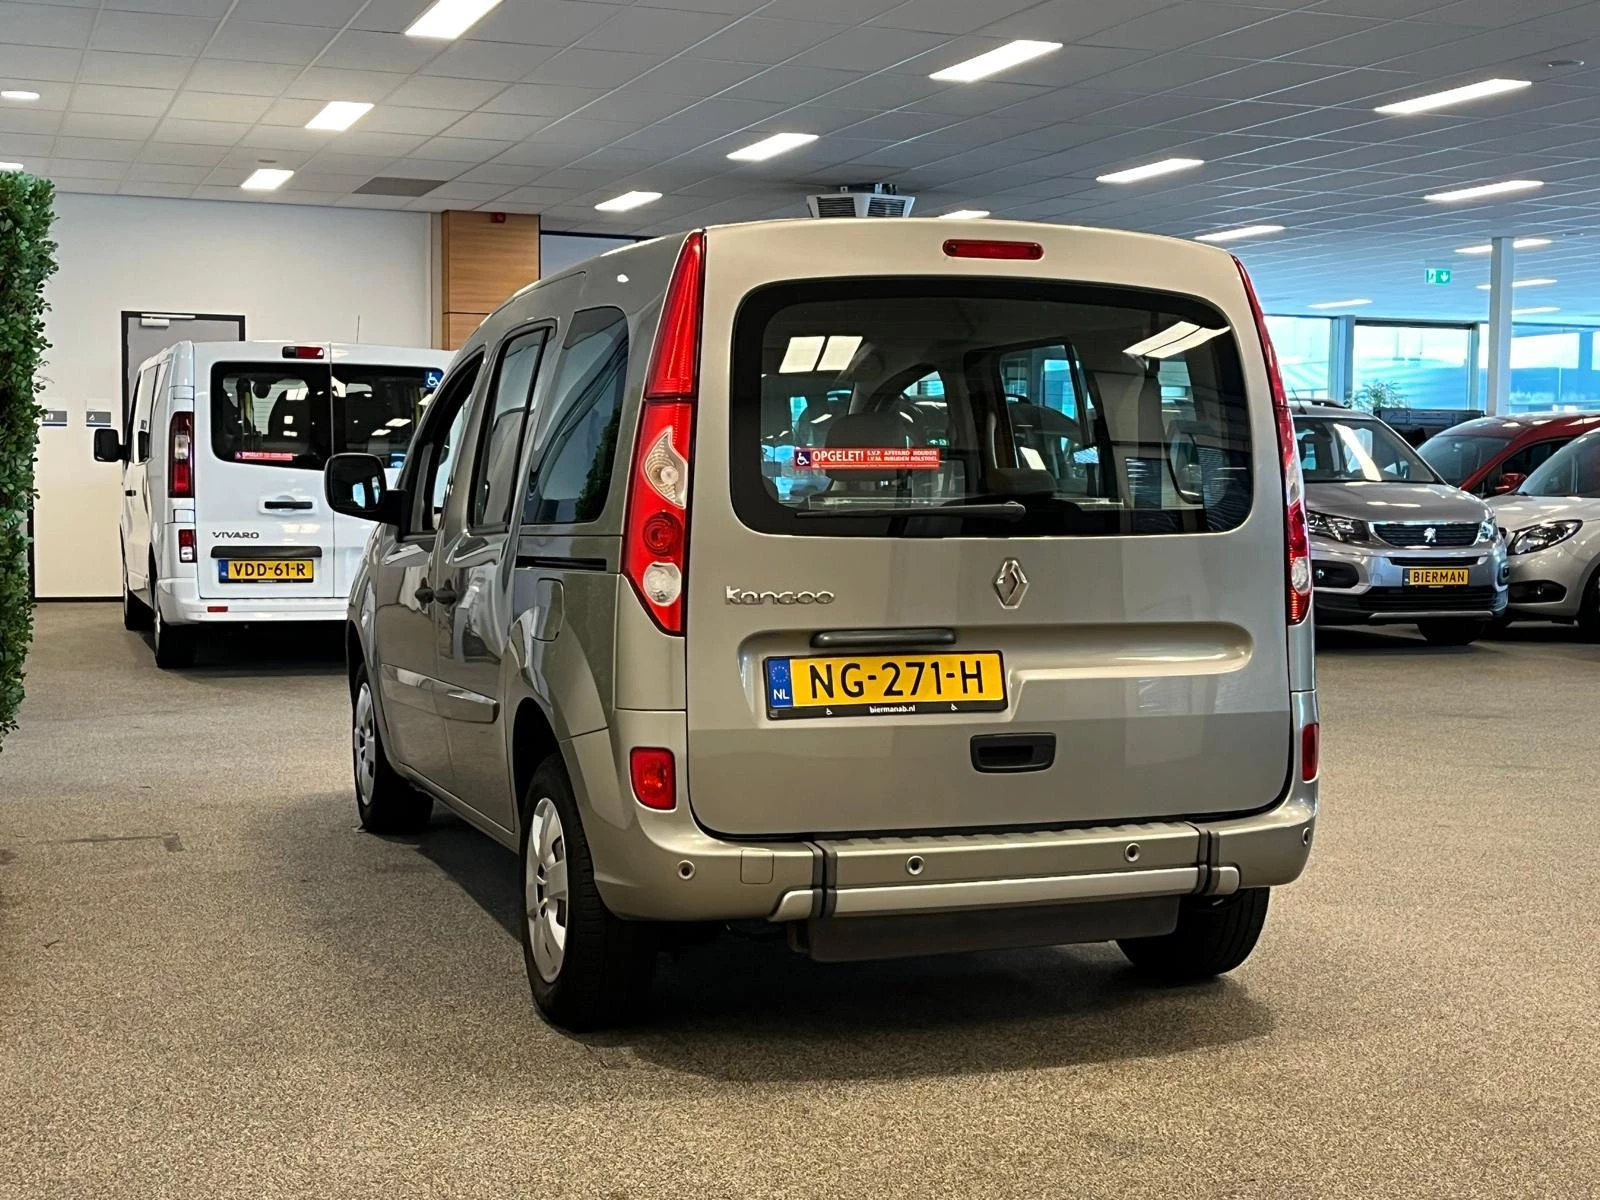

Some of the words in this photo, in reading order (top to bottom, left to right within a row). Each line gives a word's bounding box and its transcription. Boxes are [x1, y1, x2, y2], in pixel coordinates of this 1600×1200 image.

[812, 450, 864, 462] OPGELET!
[212, 531, 260, 539] VIVARO
[233, 563, 305, 577] VDD-61-R
[1413, 571, 1465, 583] BIERMAN
[809, 660, 984, 699] NG-271-H
[773, 689, 790, 700] NL
[869, 705, 916, 714] biermanab.nl
